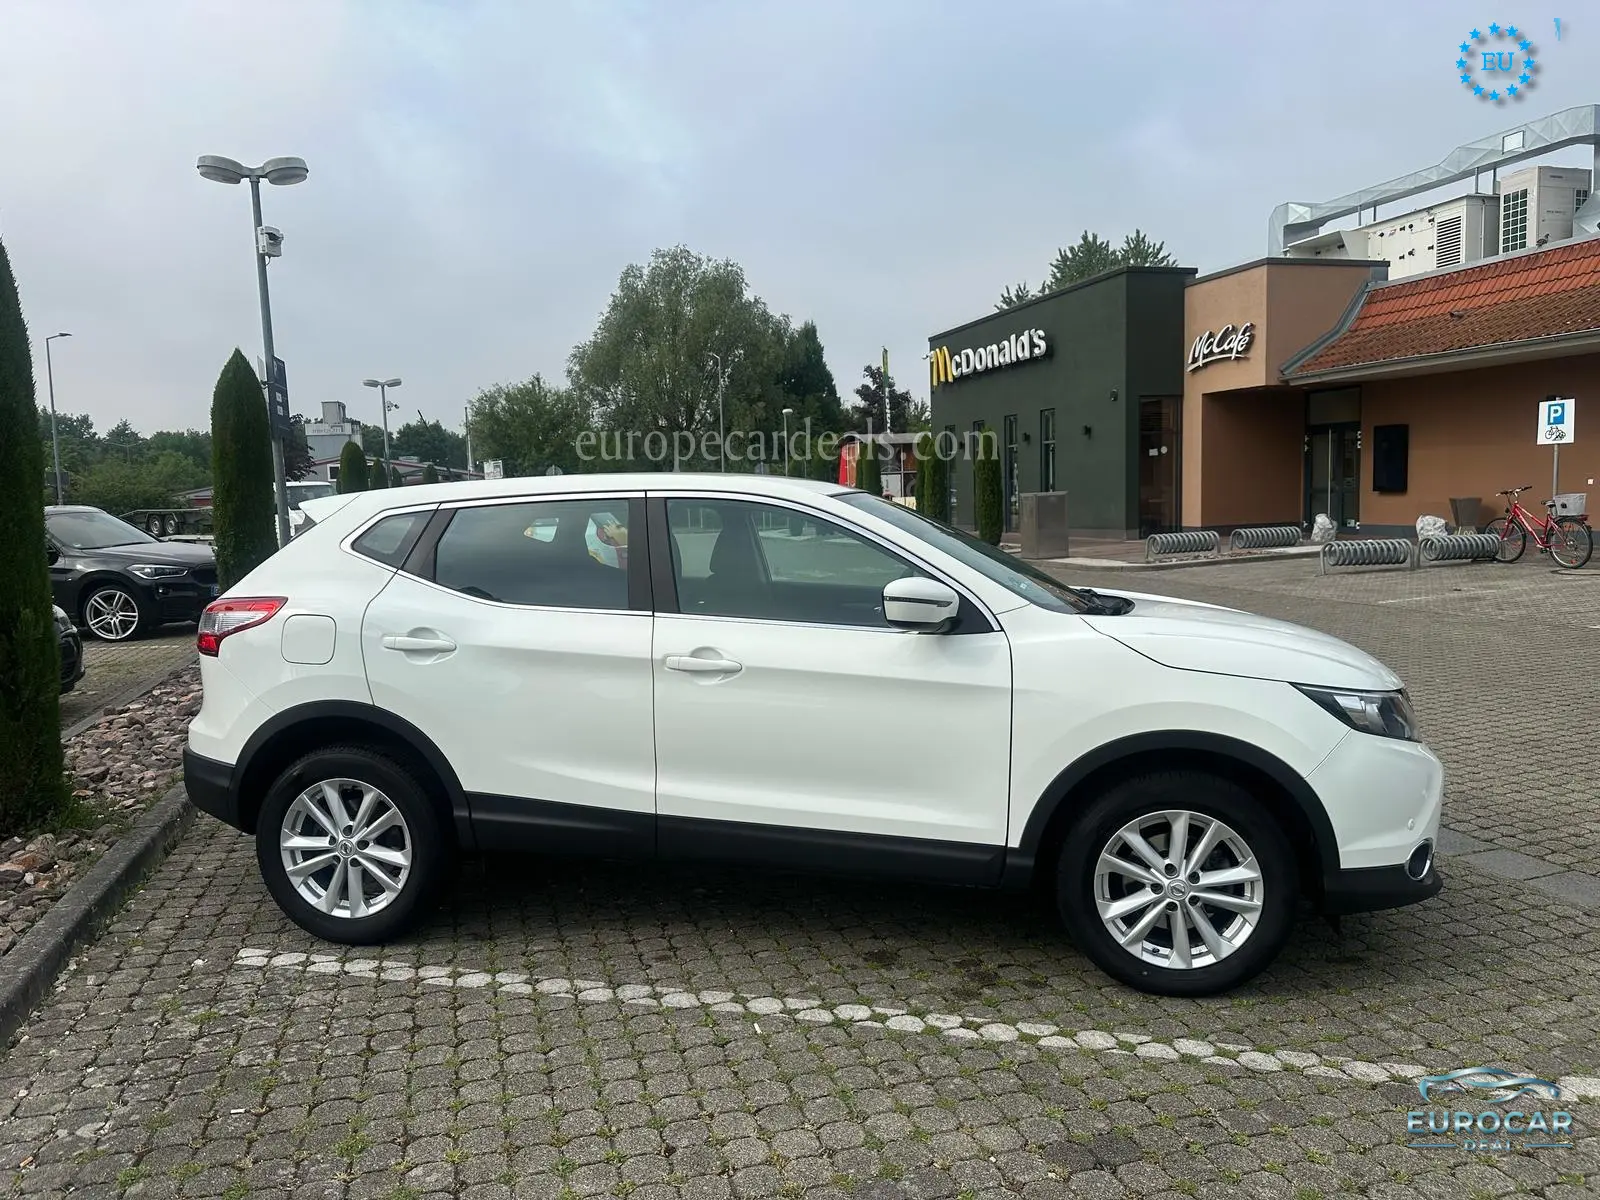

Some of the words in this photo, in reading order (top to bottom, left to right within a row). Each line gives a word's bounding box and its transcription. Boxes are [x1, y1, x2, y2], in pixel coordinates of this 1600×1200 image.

[931, 328, 1047, 386] McDonald's
[1187, 322, 1252, 368] McCafé
[1550, 405, 1562, 424] P
